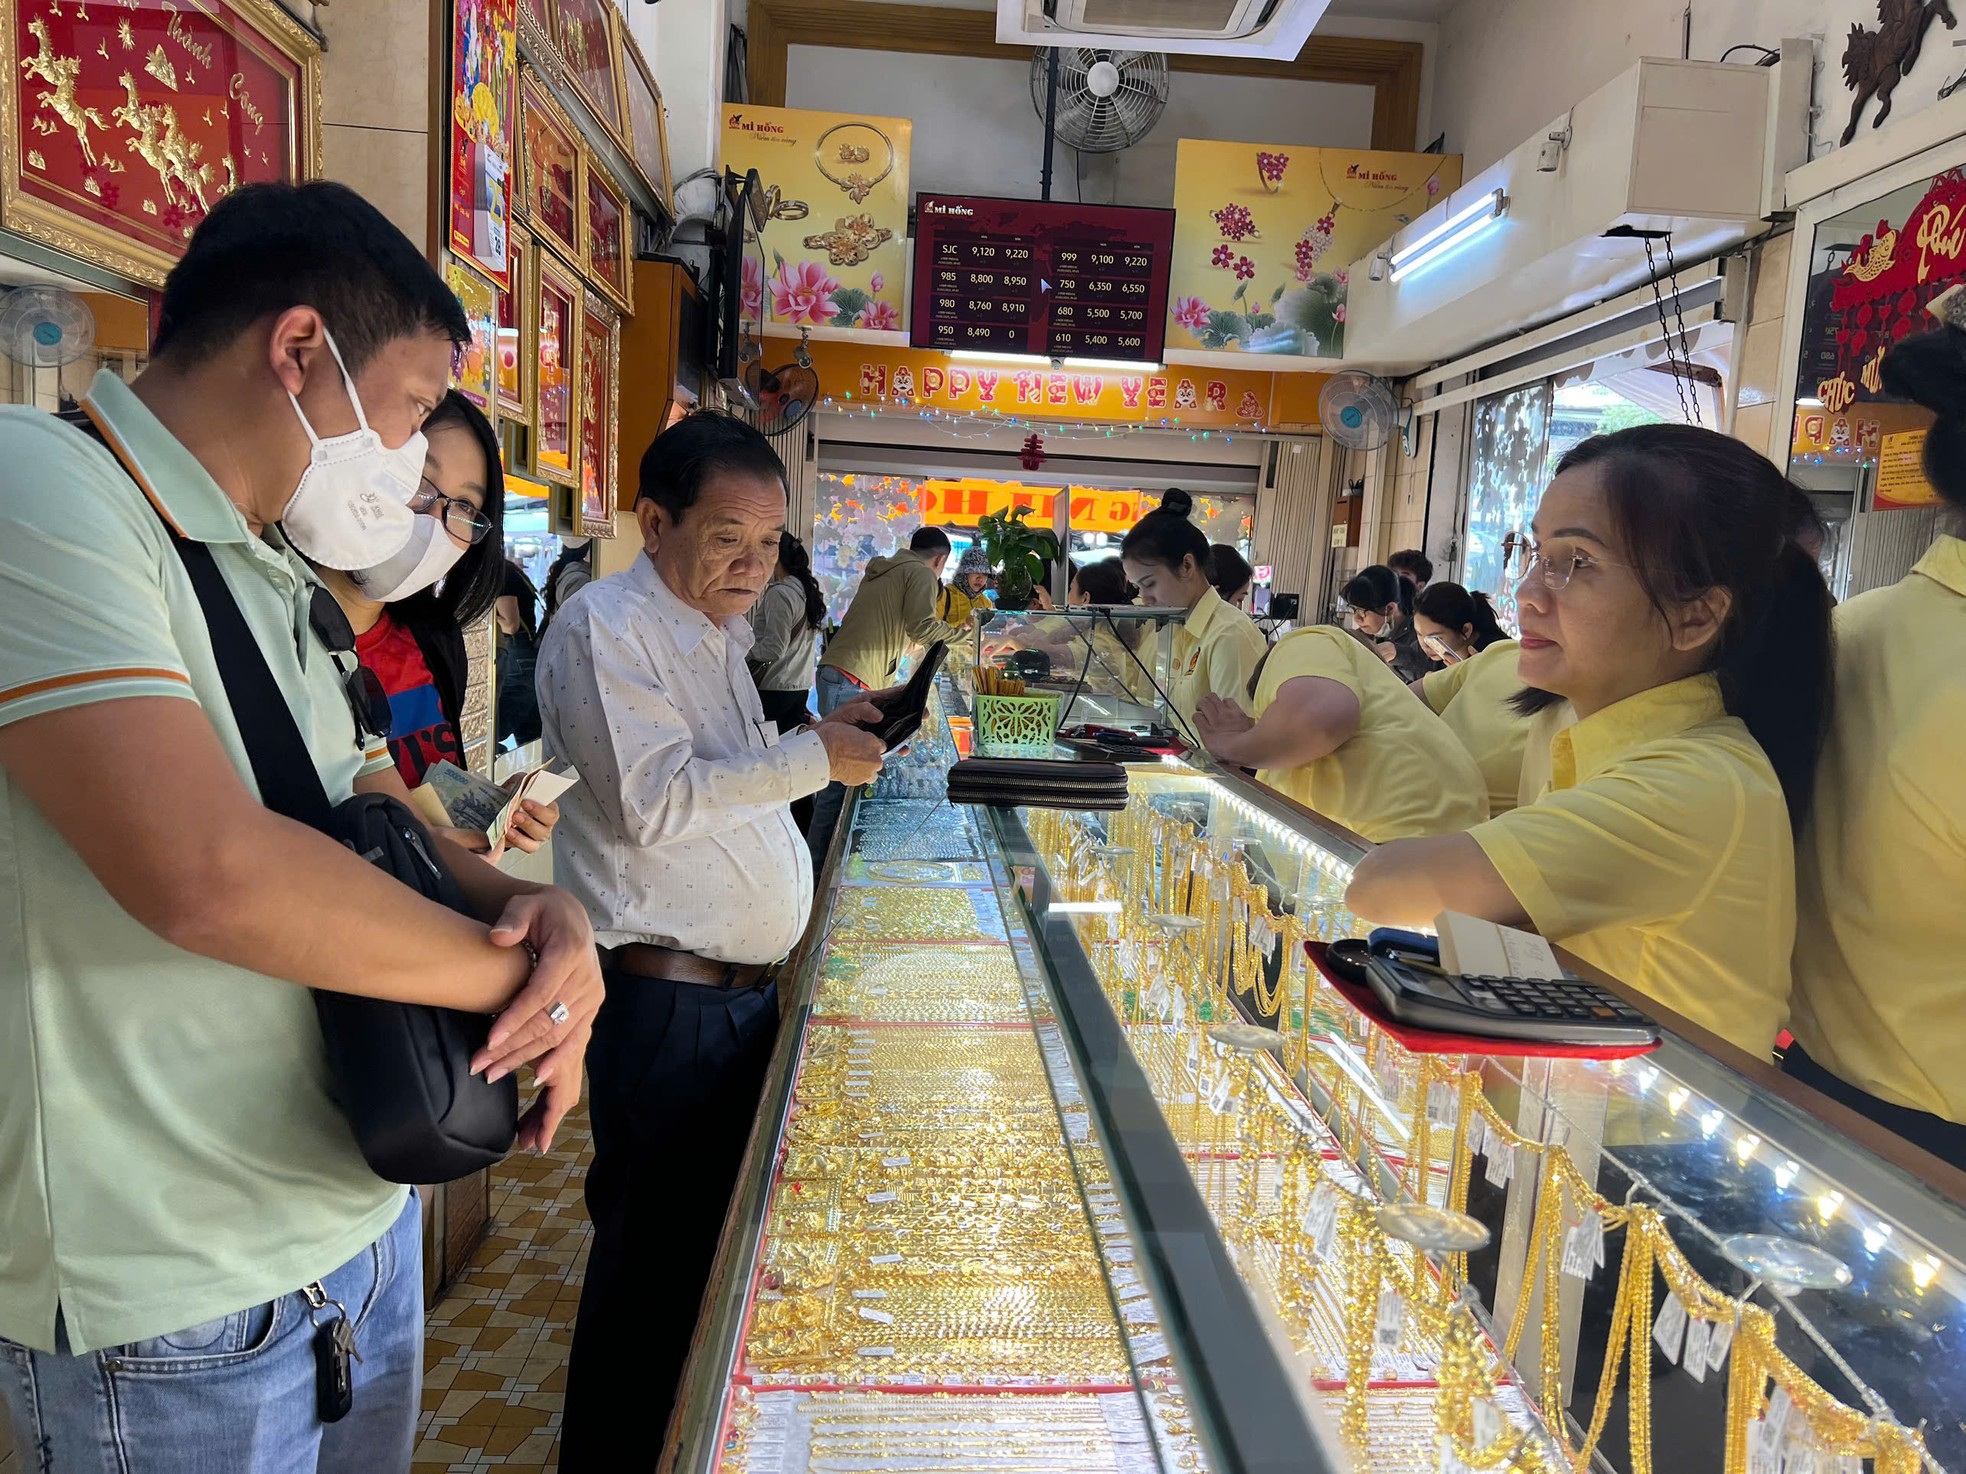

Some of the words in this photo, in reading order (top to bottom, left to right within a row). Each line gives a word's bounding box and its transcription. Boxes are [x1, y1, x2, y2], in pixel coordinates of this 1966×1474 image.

[756, 121, 784, 133] HỒNG
[948, 204, 974, 216] HỒNG
[942, 244, 958, 254] SJC
[972, 246, 995, 256] 9,120
[1005, 248, 1029, 259] 9,220
[1061, 252, 1077, 262] 999
[1091, 254, 1114, 264] 9,100
[1124, 256, 1148, 266] 9,220
[940, 271, 956, 281] 985
[970, 273, 994, 284] 8,800
[1003, 276, 1027, 286] 8,950
[1060, 279, 1076, 288] 750
[1088, 281, 1112, 292] 6,350
[1122, 284, 1145, 294] 6,550
[940, 298, 956, 308] 980
[968, 300, 992, 311] 8,760
[1002, 302, 1025, 313] 8,910
[1057, 306, 1074, 316] 680
[1086, 308, 1110, 318] 5,500
[1120, 310, 1143, 320] 5,700
[938, 326, 954, 335] 950
[967, 328, 990, 338] 8,490
[1008, 330, 1014, 338] 0
[1055, 334, 1072, 342] 610
[1084, 334, 1108, 345] 5,400
[1118, 337, 1141, 347] 5,600
[860, 364, 999, 401] HAPPY
[1013, 370, 1104, 406] NEW
[1121, 376, 1227, 412] YEAR
